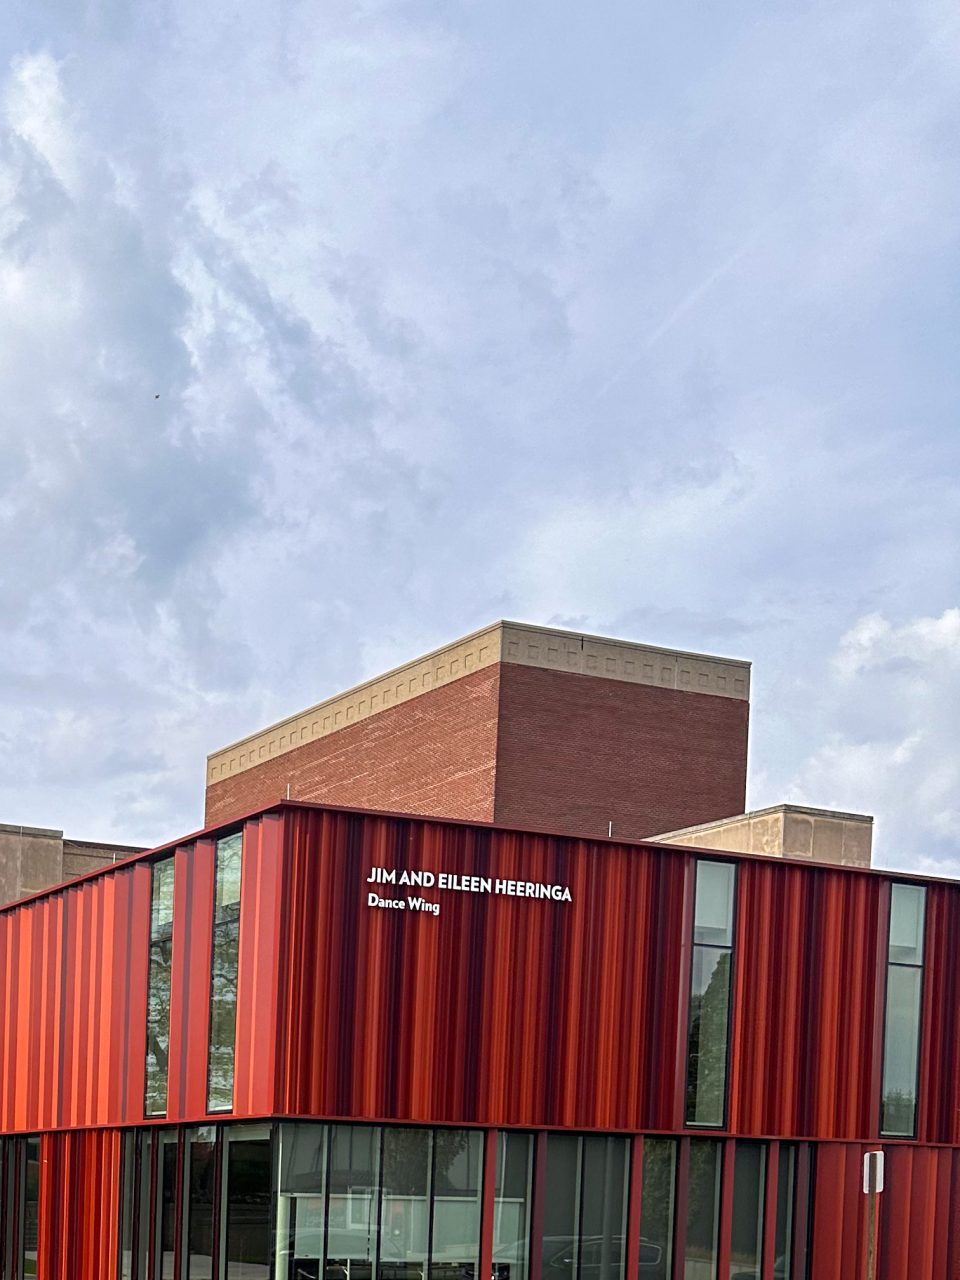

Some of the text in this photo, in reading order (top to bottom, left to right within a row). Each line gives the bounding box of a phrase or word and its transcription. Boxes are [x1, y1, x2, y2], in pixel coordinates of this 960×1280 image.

[367, 867, 573, 902] JIM AND EILEEN HEERINGA
[368, 893, 440, 916] Dance Wing
